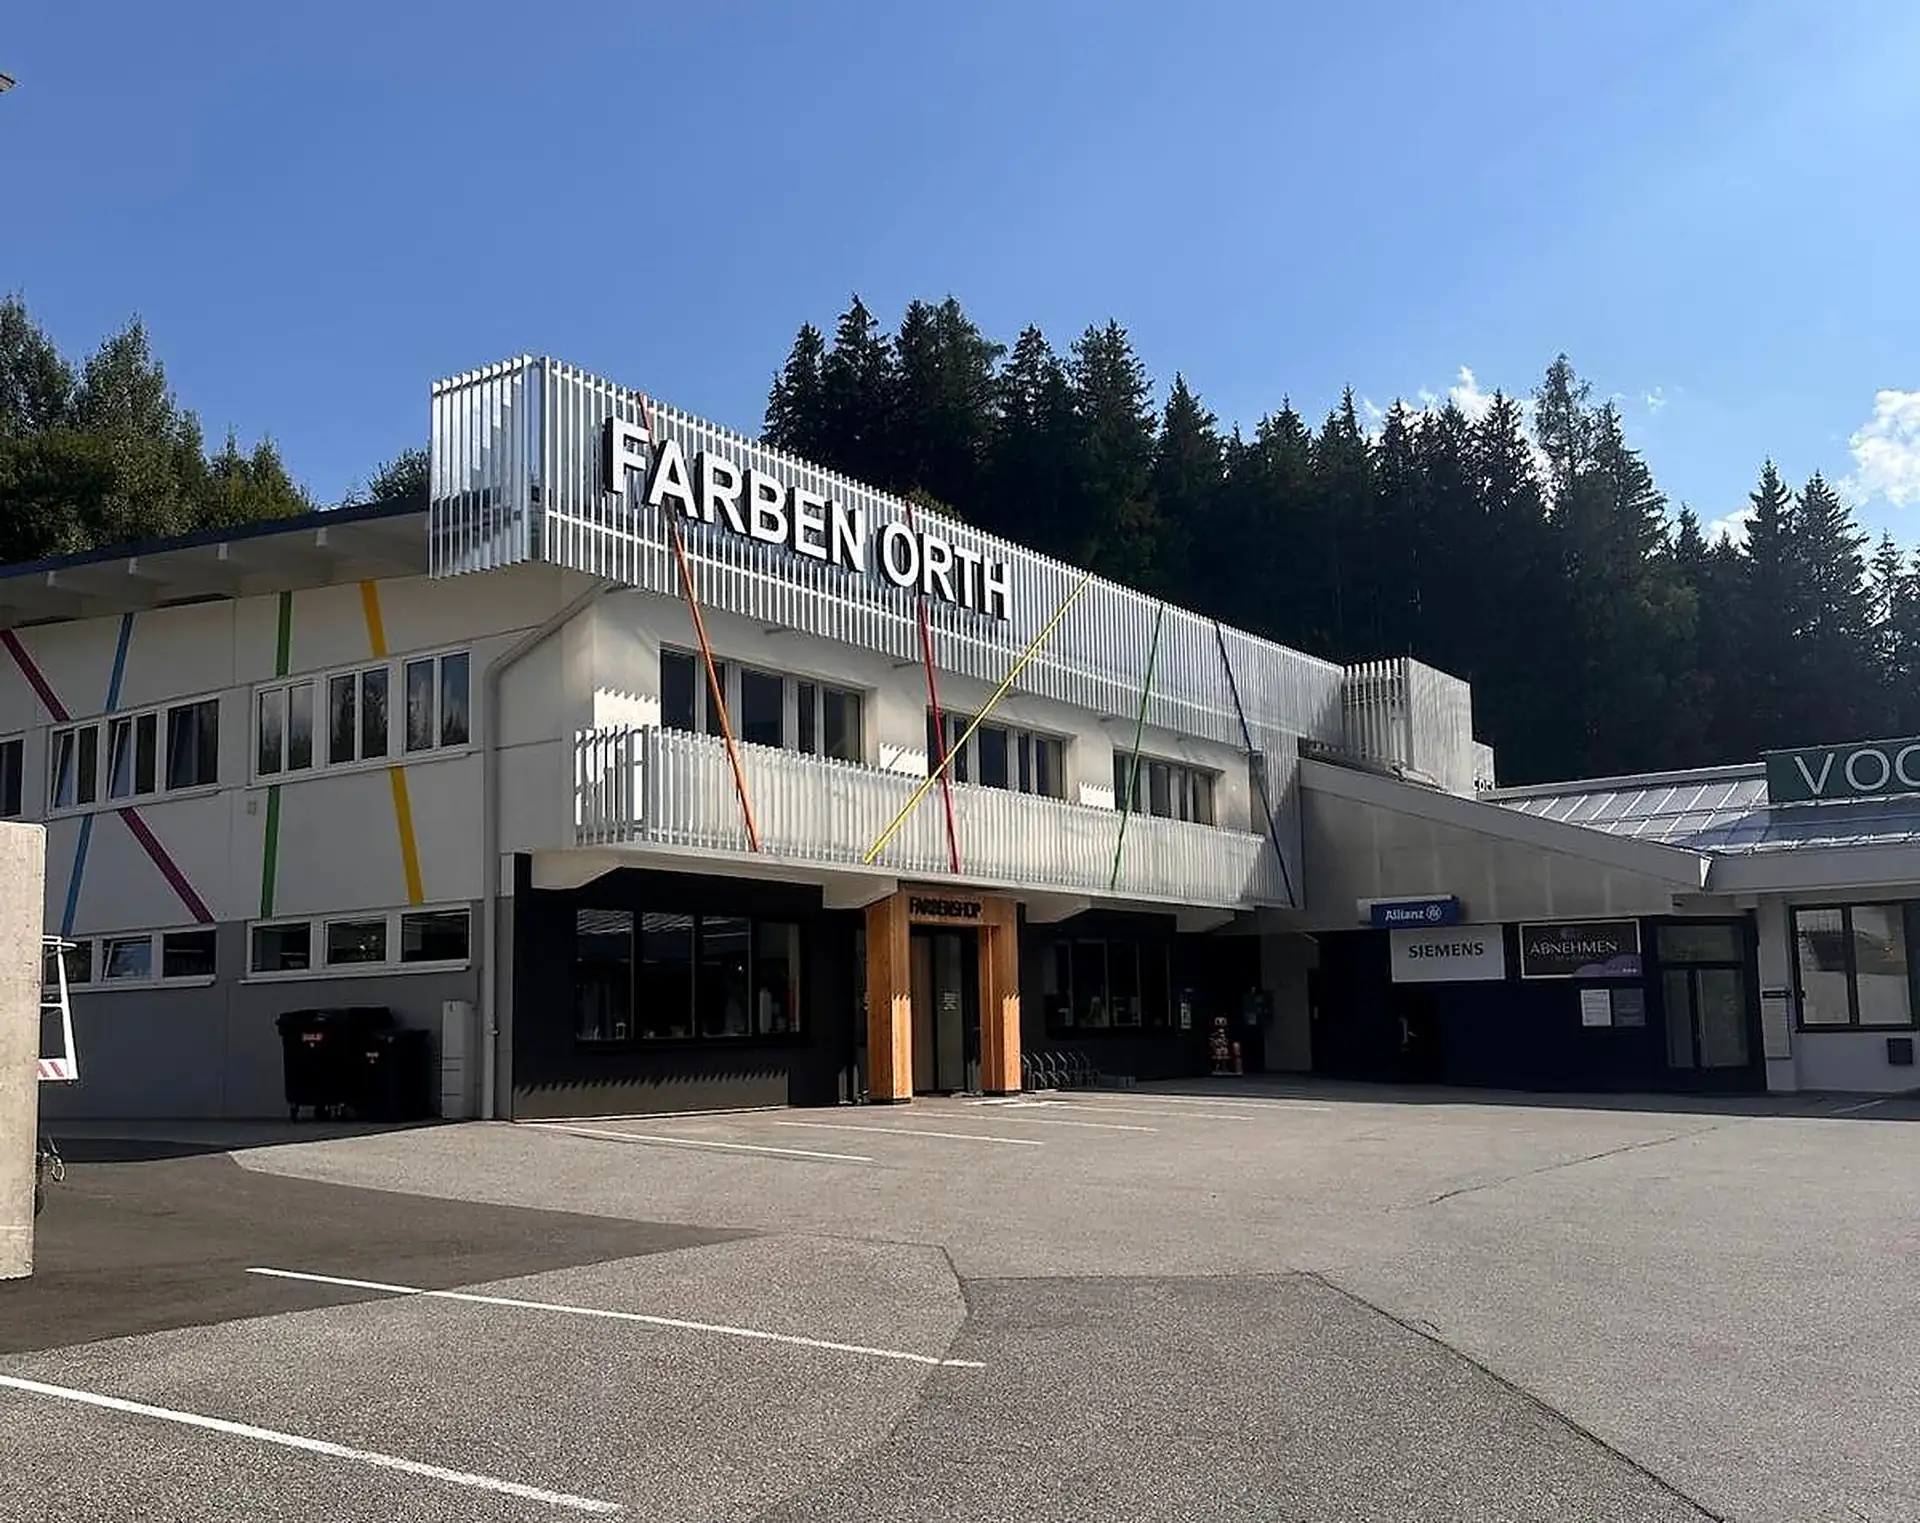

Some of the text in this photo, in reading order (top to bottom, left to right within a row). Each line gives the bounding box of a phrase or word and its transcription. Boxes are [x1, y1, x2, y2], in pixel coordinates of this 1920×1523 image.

[607, 417, 1012, 620] FARBEN ORTH
[1384, 909, 1425, 921] Allianz
[1408, 942, 1484, 959] SIEMENS
[1529, 940, 1618, 956] ABNEHMEN
